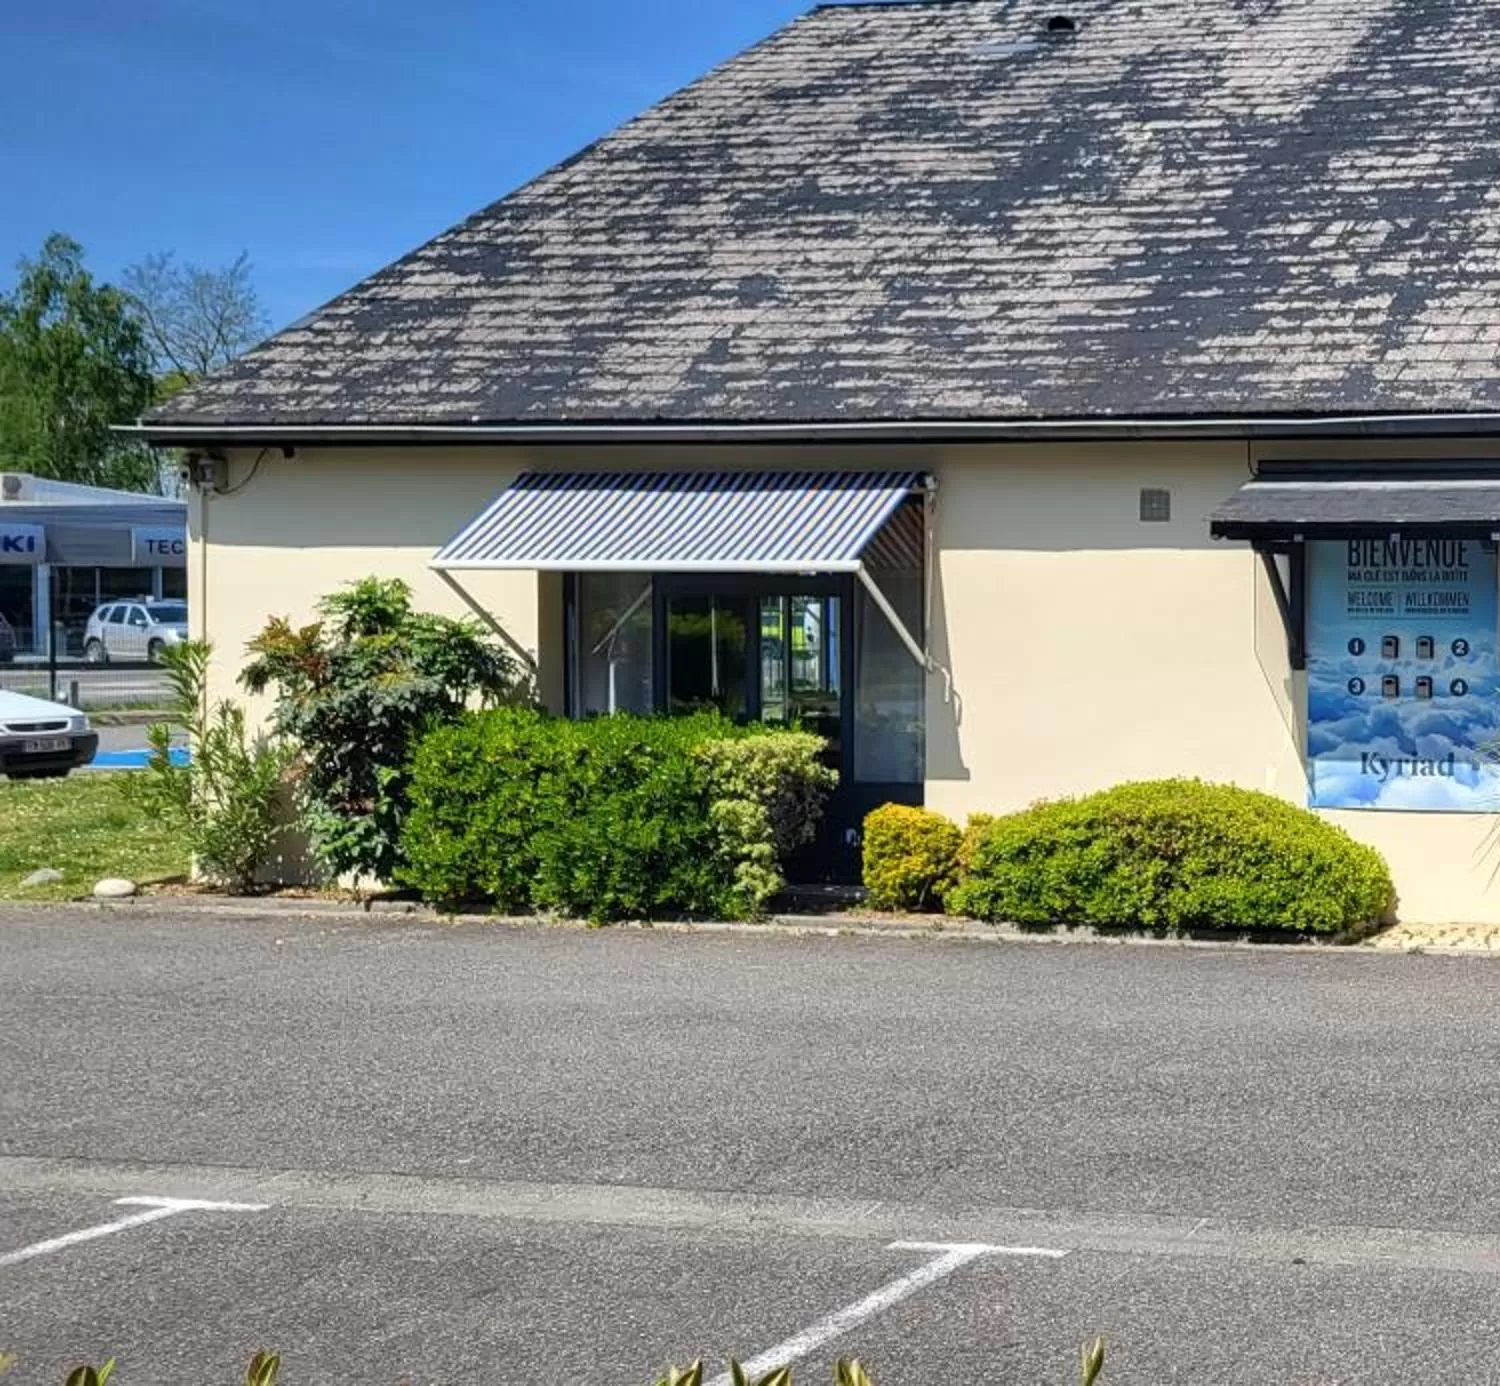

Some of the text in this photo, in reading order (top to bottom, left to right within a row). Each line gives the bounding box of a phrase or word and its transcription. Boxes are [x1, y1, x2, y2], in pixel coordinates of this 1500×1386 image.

[1347, 539, 1470, 567] BIENVENUE
[1347, 591, 1393, 606] WELCOME
[1360, 751, 1455, 783] Kyriad
